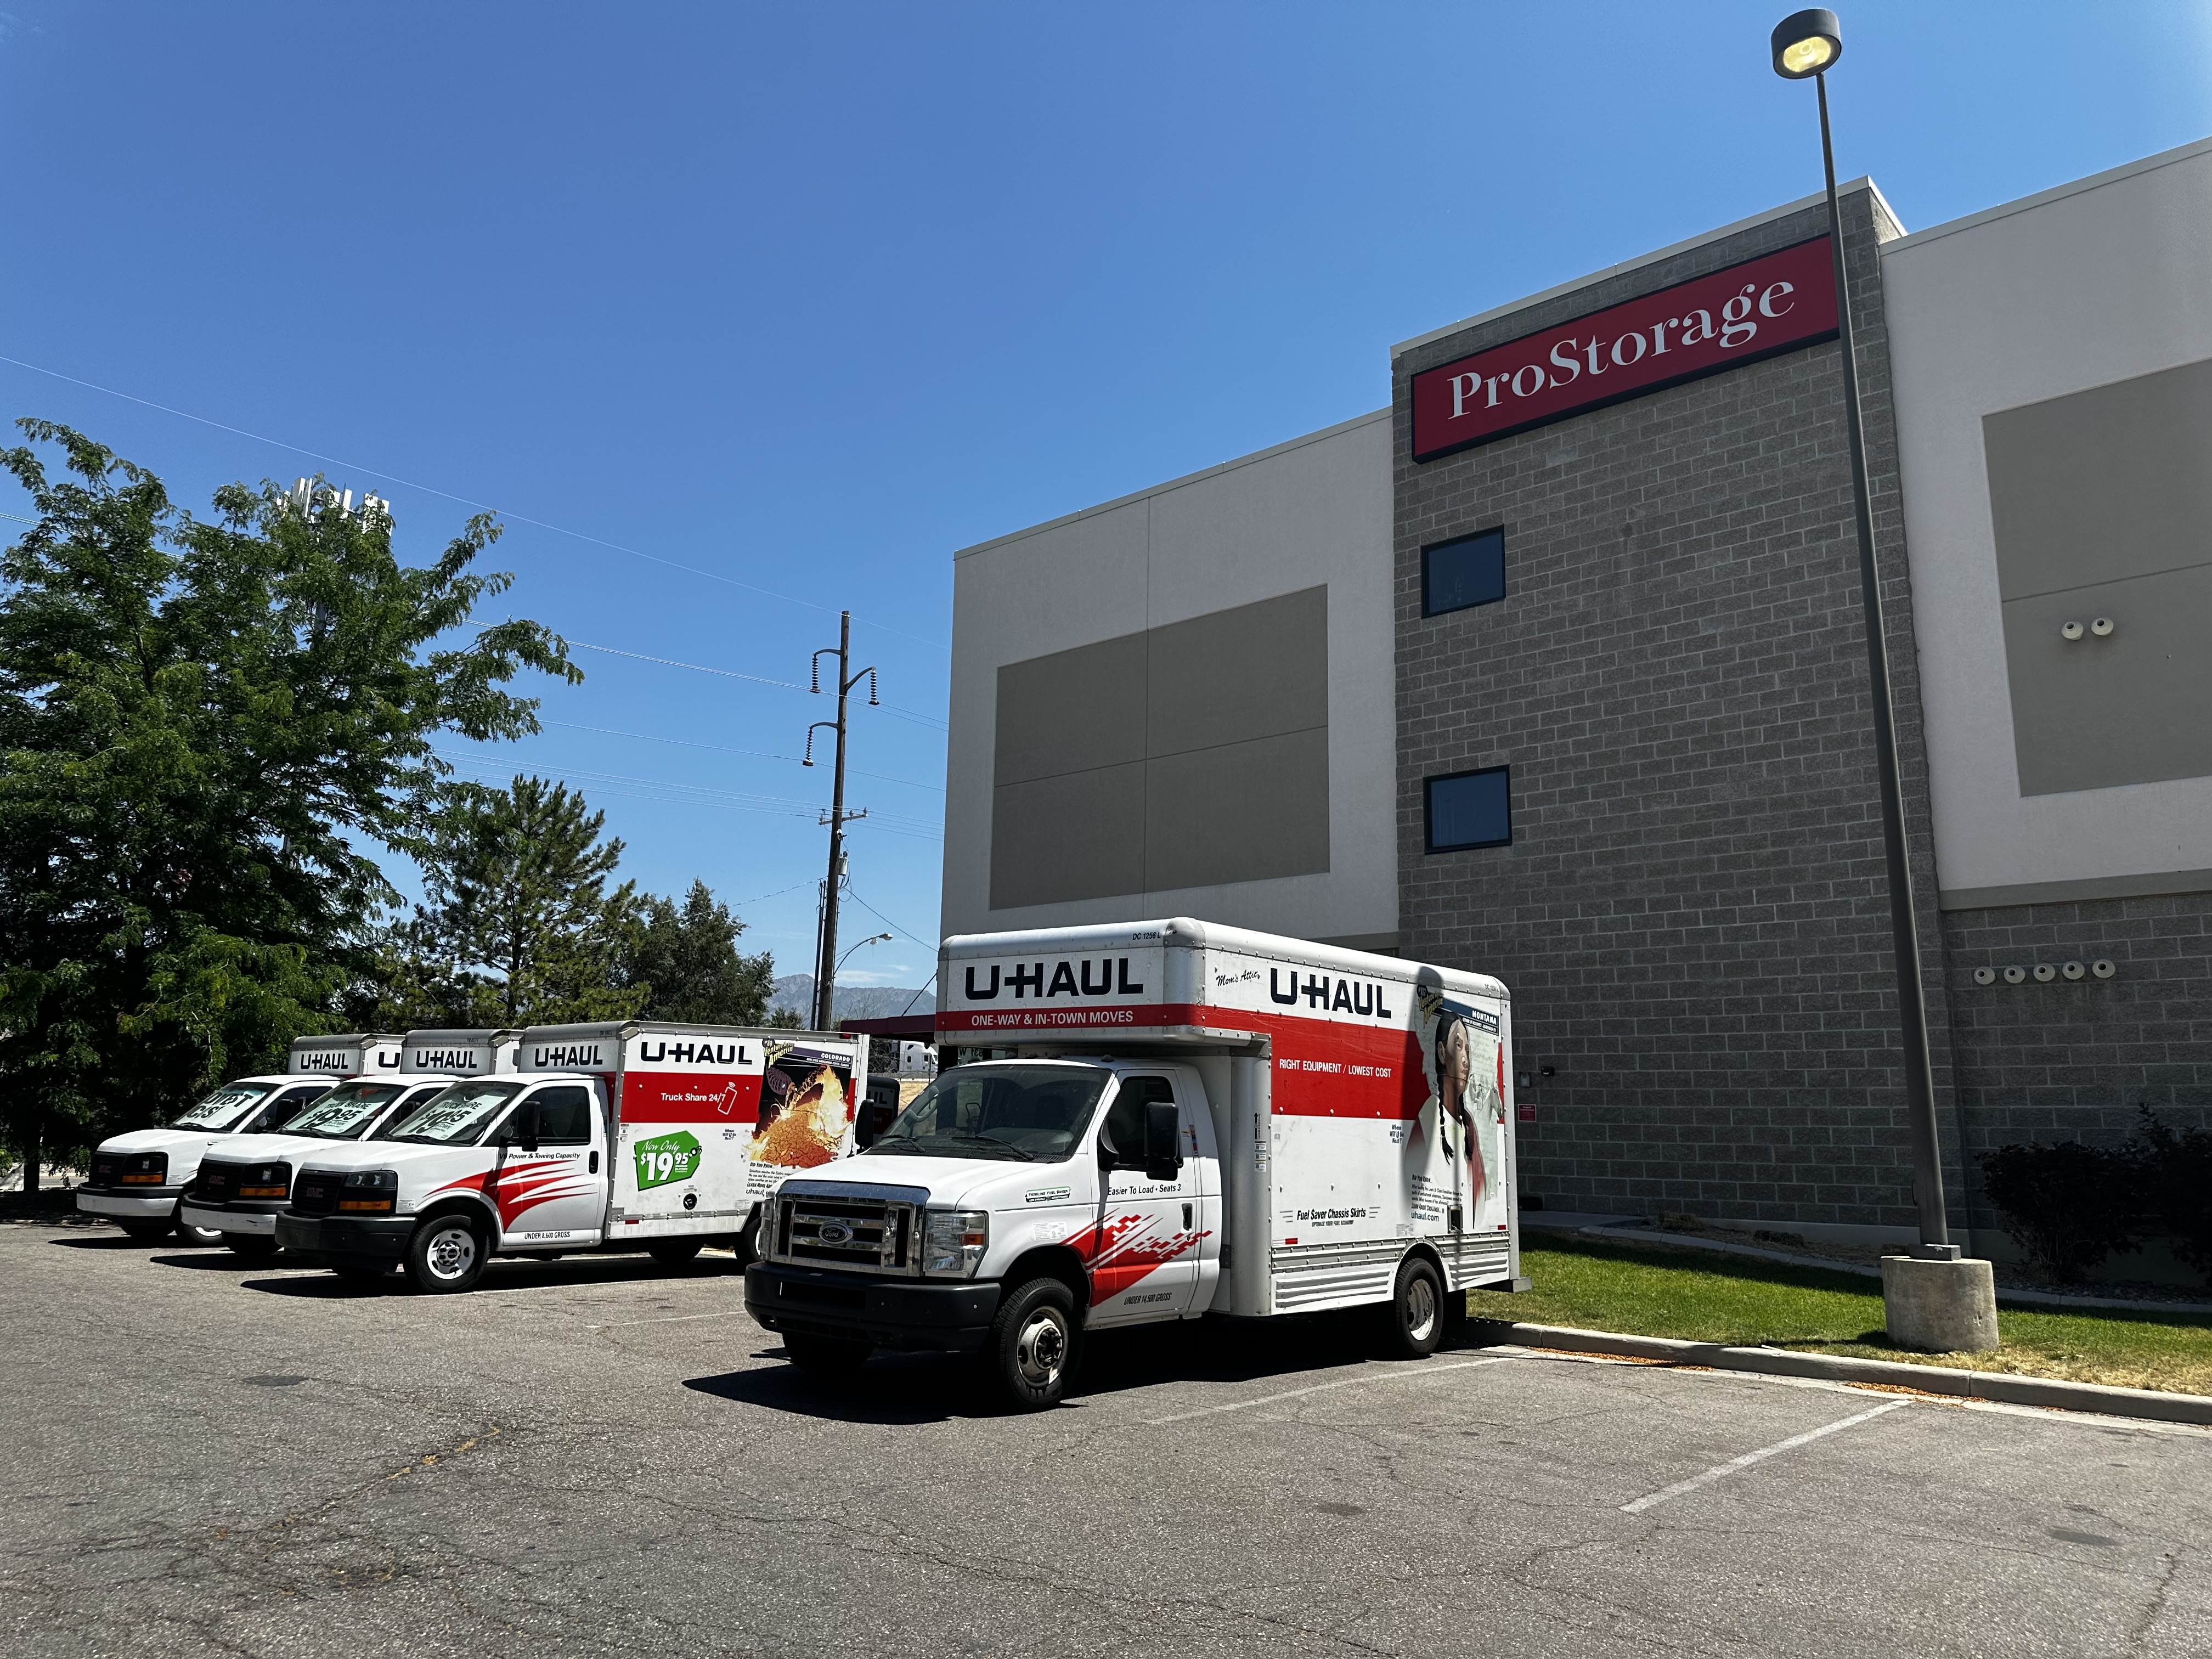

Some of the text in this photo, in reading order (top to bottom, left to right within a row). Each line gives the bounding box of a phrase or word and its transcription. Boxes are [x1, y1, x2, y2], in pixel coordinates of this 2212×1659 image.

[1447, 281, 1795, 420] ProStorage
[965, 958, 1143, 1000] U-HAUL
[1216, 969, 1258, 986] Mom's Attic
[1271, 968, 1391, 1019] U-HAUL
[972, 1011, 1133, 1026] ONE-WAY & IN-TOWN MOVES
[1472, 1010, 1497, 1025] MONTANA
[416, 1051, 477, 1069] U-HAUL
[535, 1046, 603, 1067] U-HAUL
[641, 1041, 752, 1065] U-HAUL
[769, 1047, 793, 1069] America
[821, 1053, 850, 1062] COLORADO
[301, 1053, 348, 1069] U-HAUL
[1280, 1059, 1300, 1070] RIGHT
[1303, 1060, 1342, 1073] EQUIPMENT
[1348, 1065, 1374, 1076] LOWEST
[1375, 1068, 1392, 1077] COST
[661, 1093, 683, 1101] Truck
[709, 1093, 726, 1103] 24/7
[642, 1140, 680, 1154] Now Only
[1108, 1187, 1127, 1195] Easier
[1130, 1186, 1137, 1194] To
[1139, 1185, 1154, 1194] Load
[1297, 1210, 1310, 1221] Fuel
[1328, 1208, 1349, 1218] Chassis
[1351, 1207, 1366, 1218] Skirts
[1412, 1211, 1439, 1222] uhaul.com
[825, 1228, 839, 1237] Ford
[1124, 1296, 1141, 1305] UNDER
[1155, 1293, 1172, 1302] GROSS
